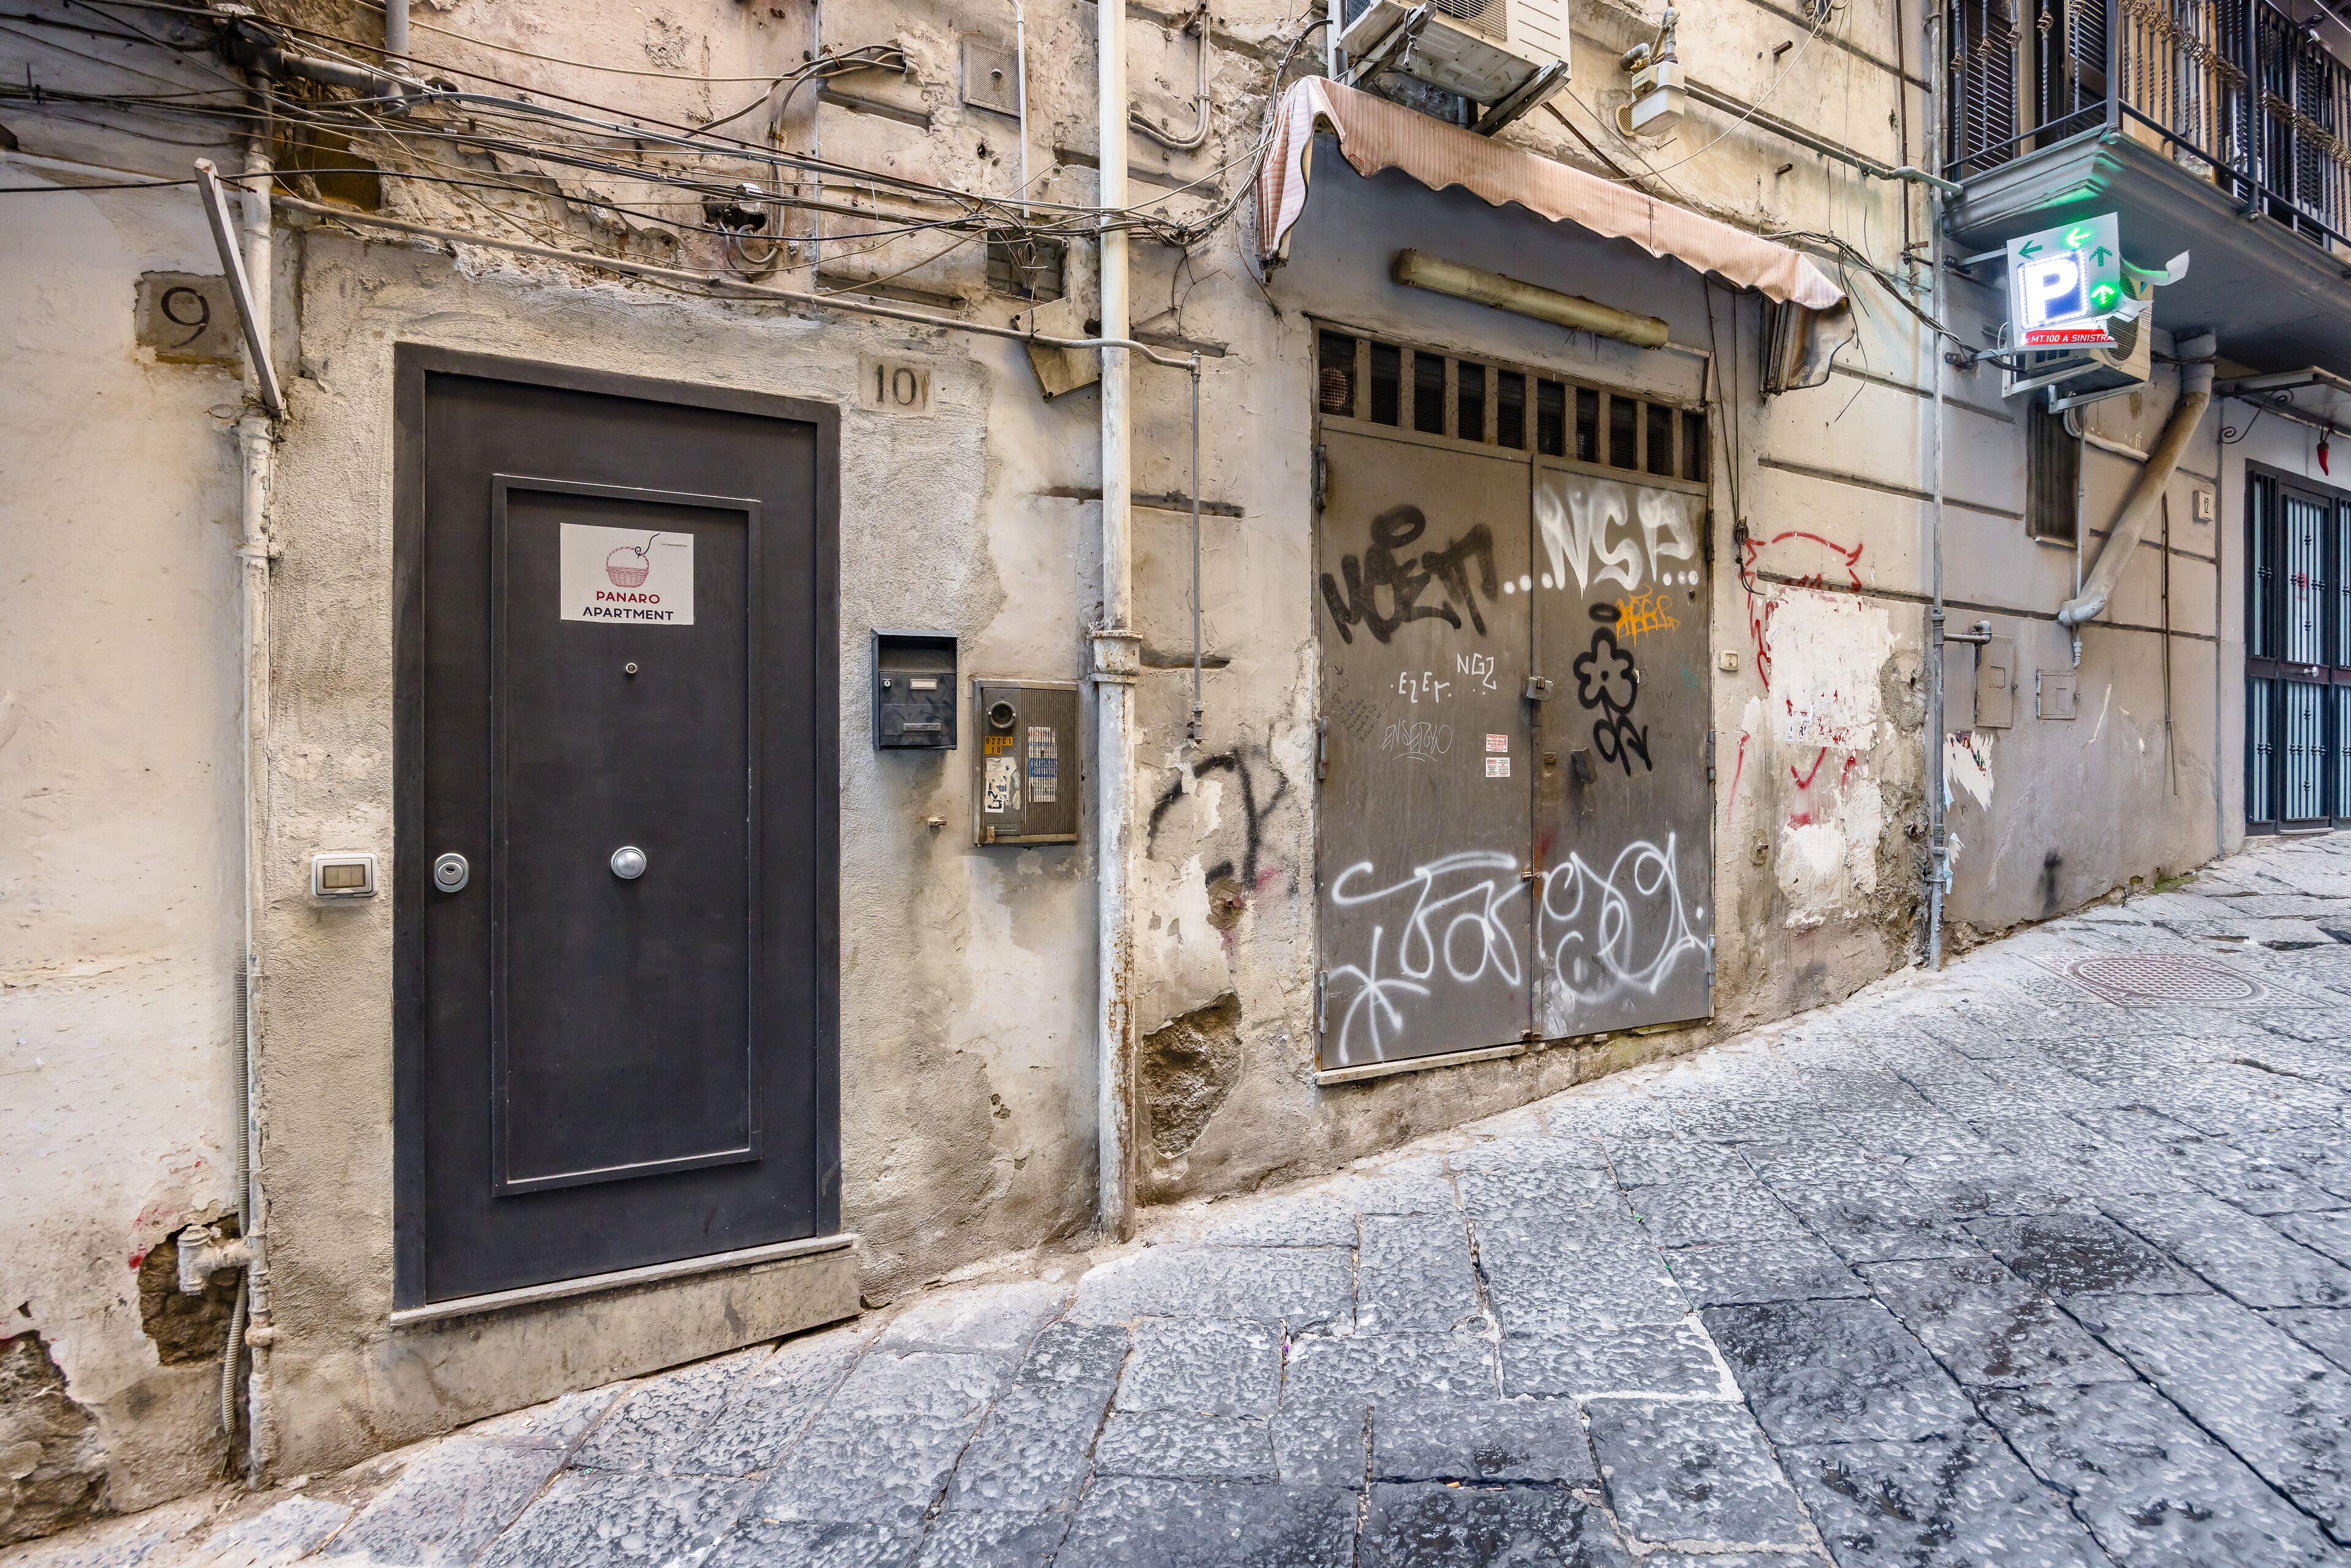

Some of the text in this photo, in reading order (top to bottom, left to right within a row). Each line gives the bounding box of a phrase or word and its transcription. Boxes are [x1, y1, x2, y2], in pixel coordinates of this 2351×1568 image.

[2025, 259, 2079, 324] P
[160, 286, 210, 348] 9
[2031, 334, 2060, 343] MT.100
[874, 364, 917, 405] 10
[2203, 497, 2209, 514] 12
[596, 591, 661, 604] PANARO
[582, 607, 674, 621] APARTMENT
